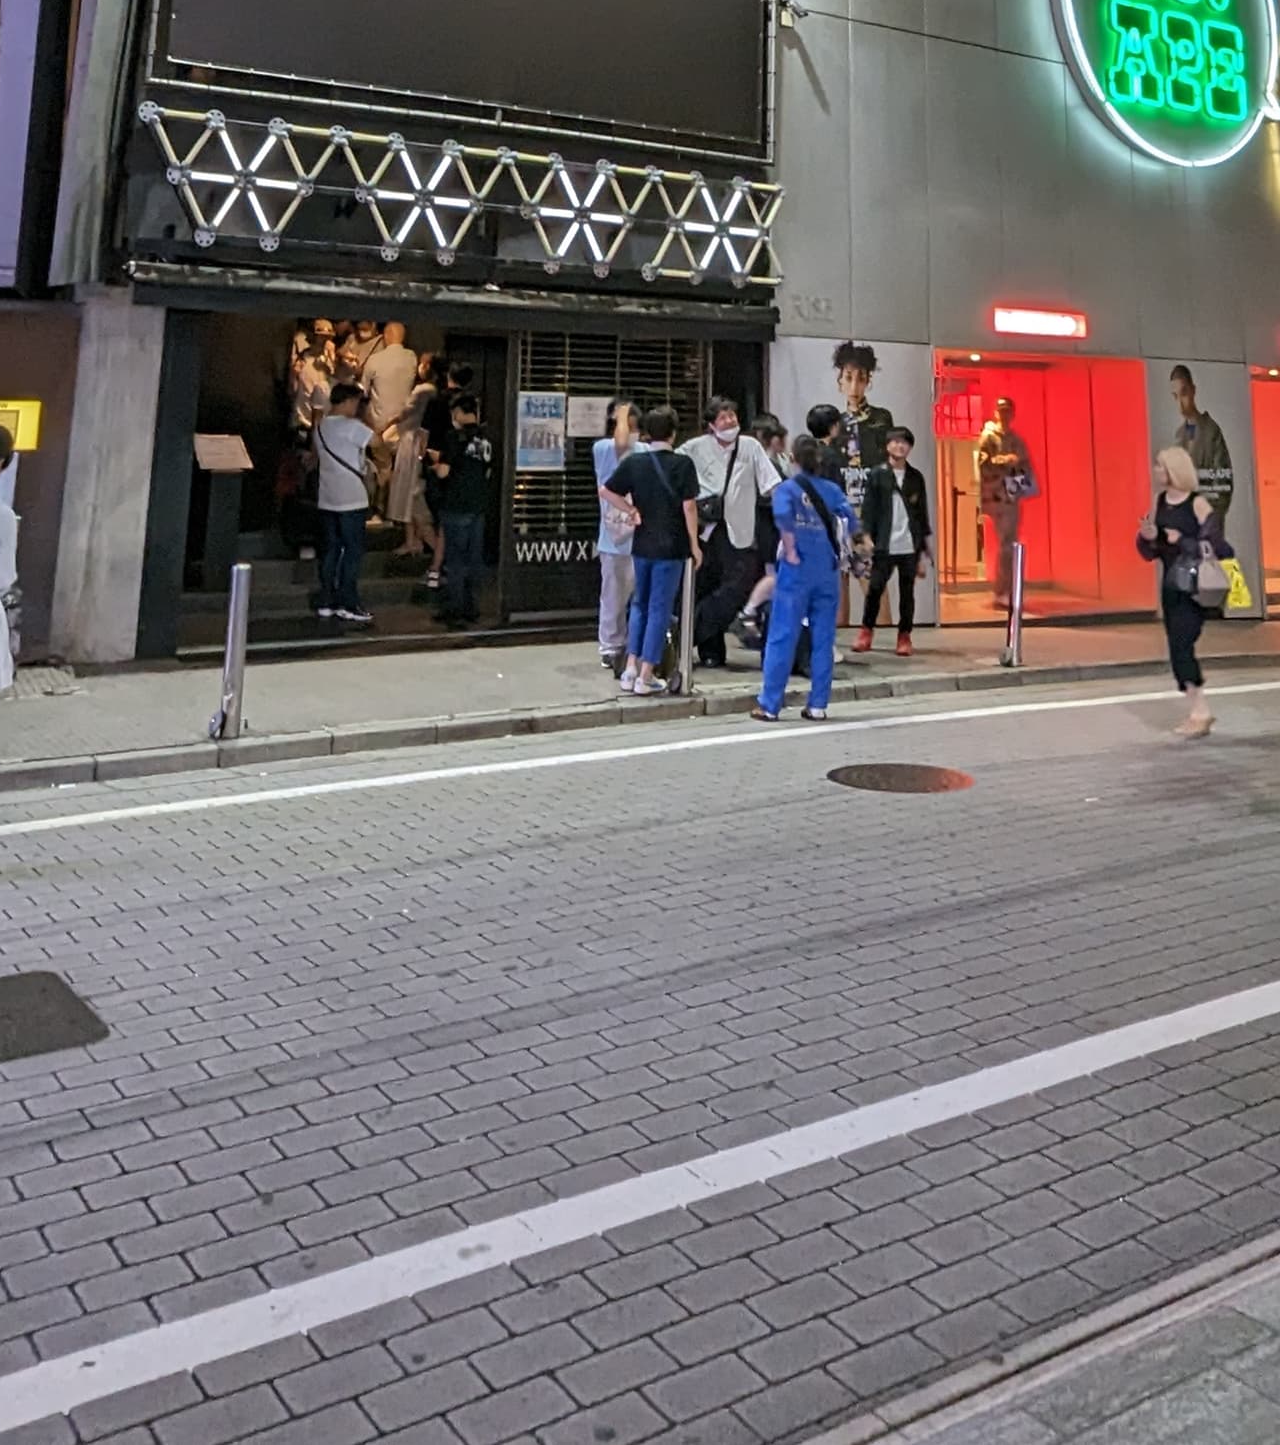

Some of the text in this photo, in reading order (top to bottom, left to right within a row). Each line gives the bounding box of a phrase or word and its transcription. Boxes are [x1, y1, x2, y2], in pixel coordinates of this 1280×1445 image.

[1109, 0, 1248, 121] APE
[515, 539, 589, 563] WWW X
